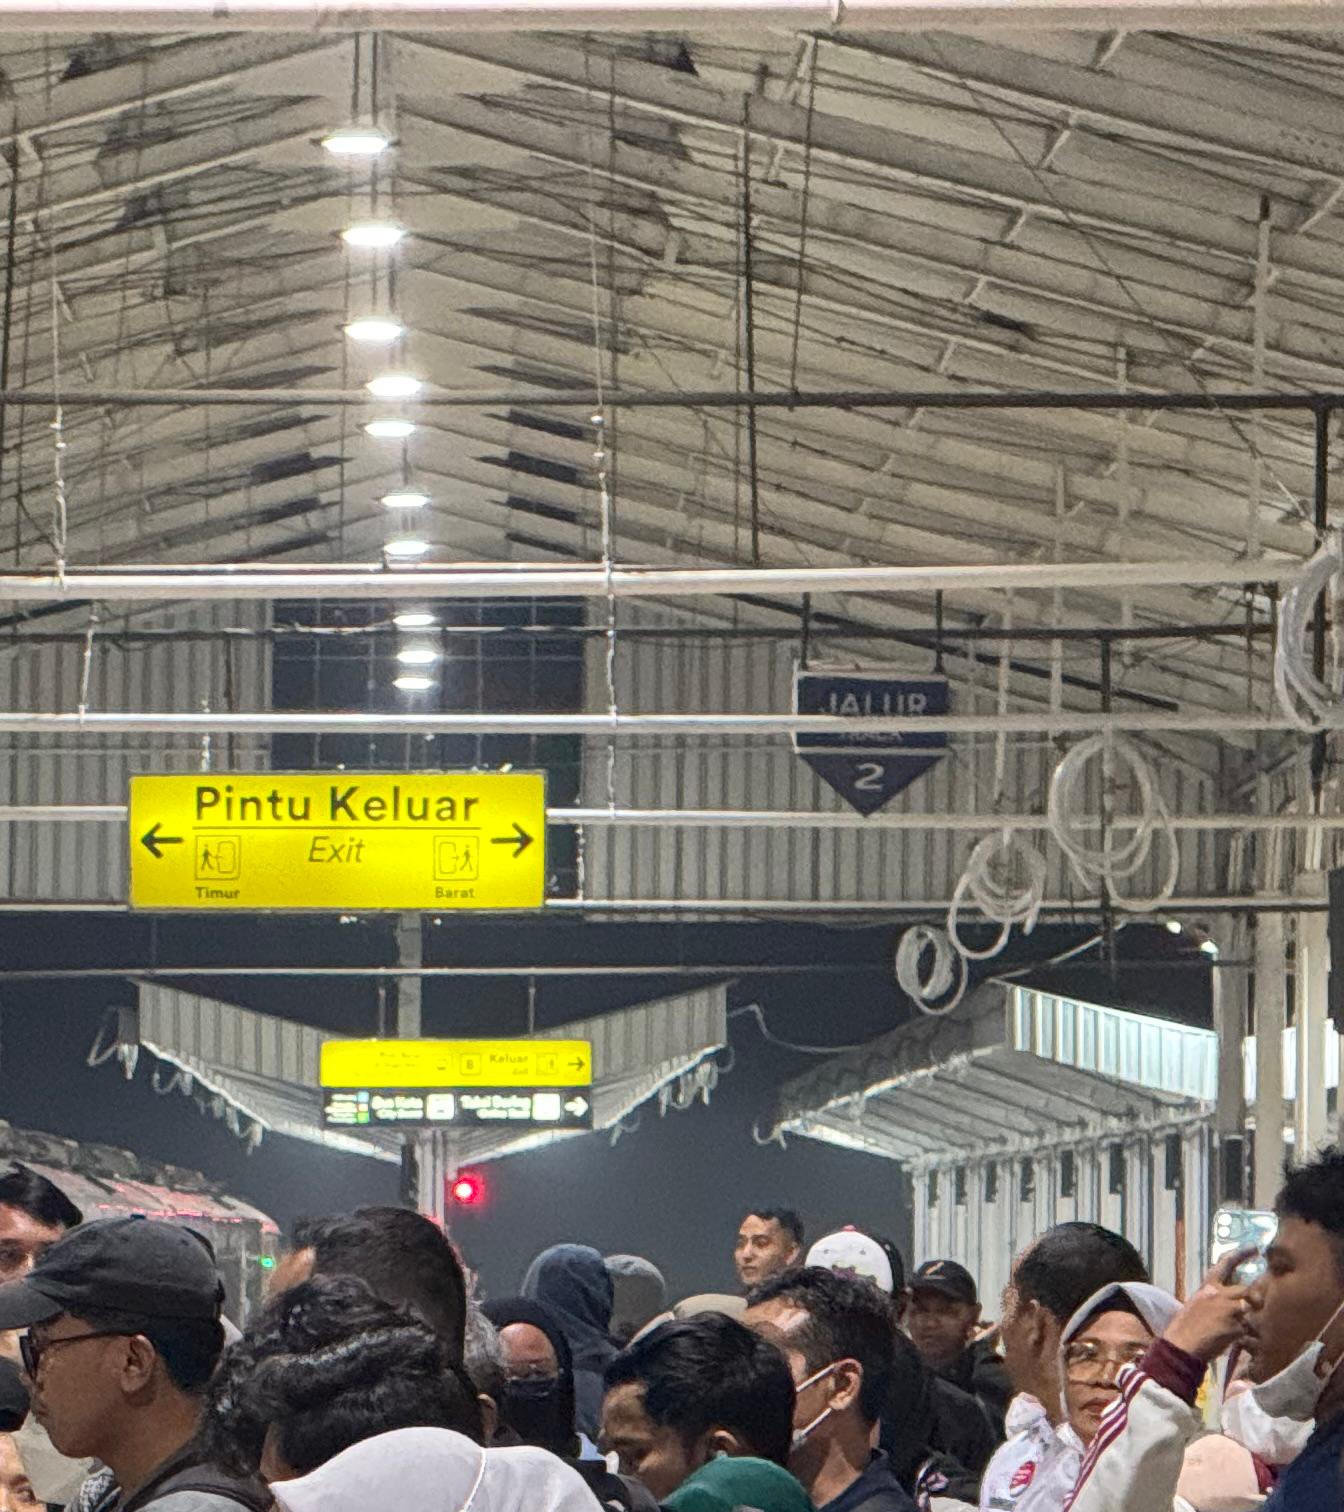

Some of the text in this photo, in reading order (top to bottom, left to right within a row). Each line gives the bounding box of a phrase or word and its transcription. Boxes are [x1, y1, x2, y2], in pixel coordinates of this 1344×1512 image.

[854, 762, 884, 791] 2
[195, 785, 479, 822] Pintu Keluar
[308, 834, 364, 863] Exit
[195, 886, 240, 899] Timur
[435, 886, 474, 899] Barat
